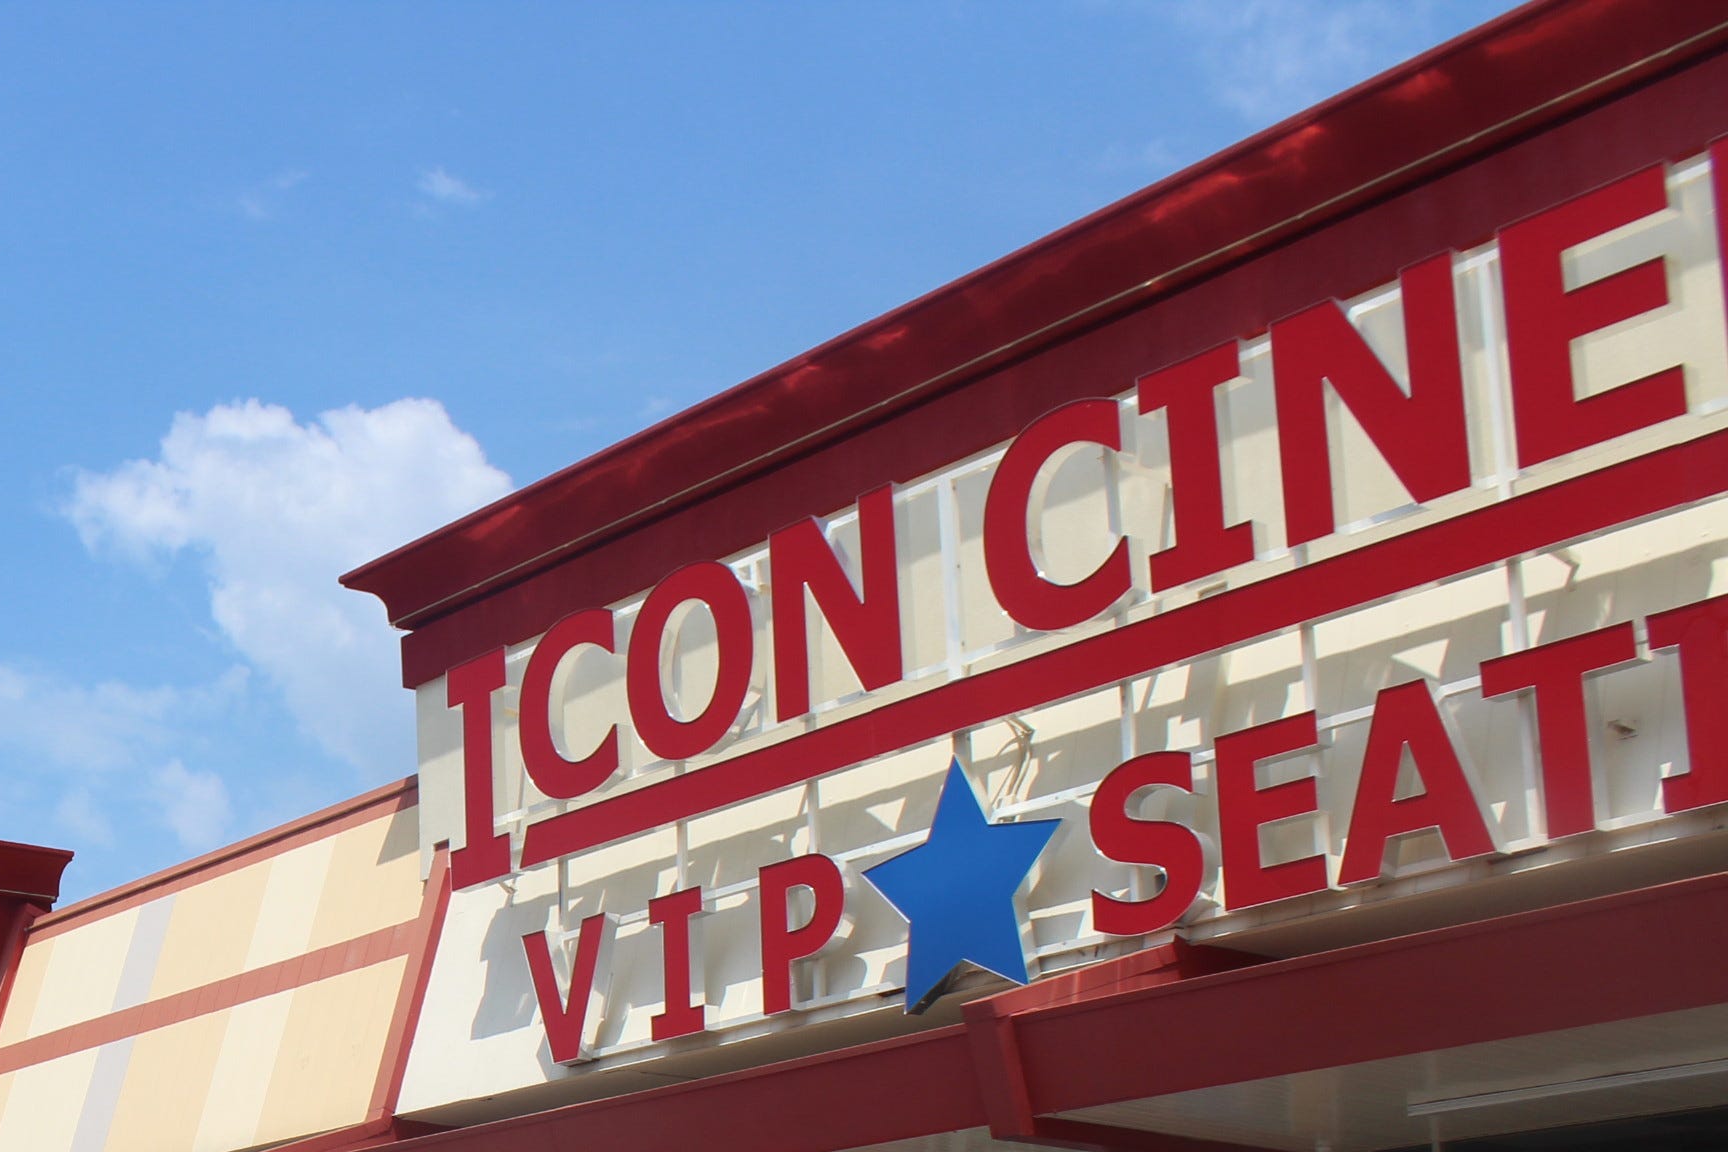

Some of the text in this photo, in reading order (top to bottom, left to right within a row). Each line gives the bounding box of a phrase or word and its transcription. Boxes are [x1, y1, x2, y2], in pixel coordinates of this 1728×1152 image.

[446, 135, 1728, 891] ICON CINE
[523, 853, 845, 1065] VIP
